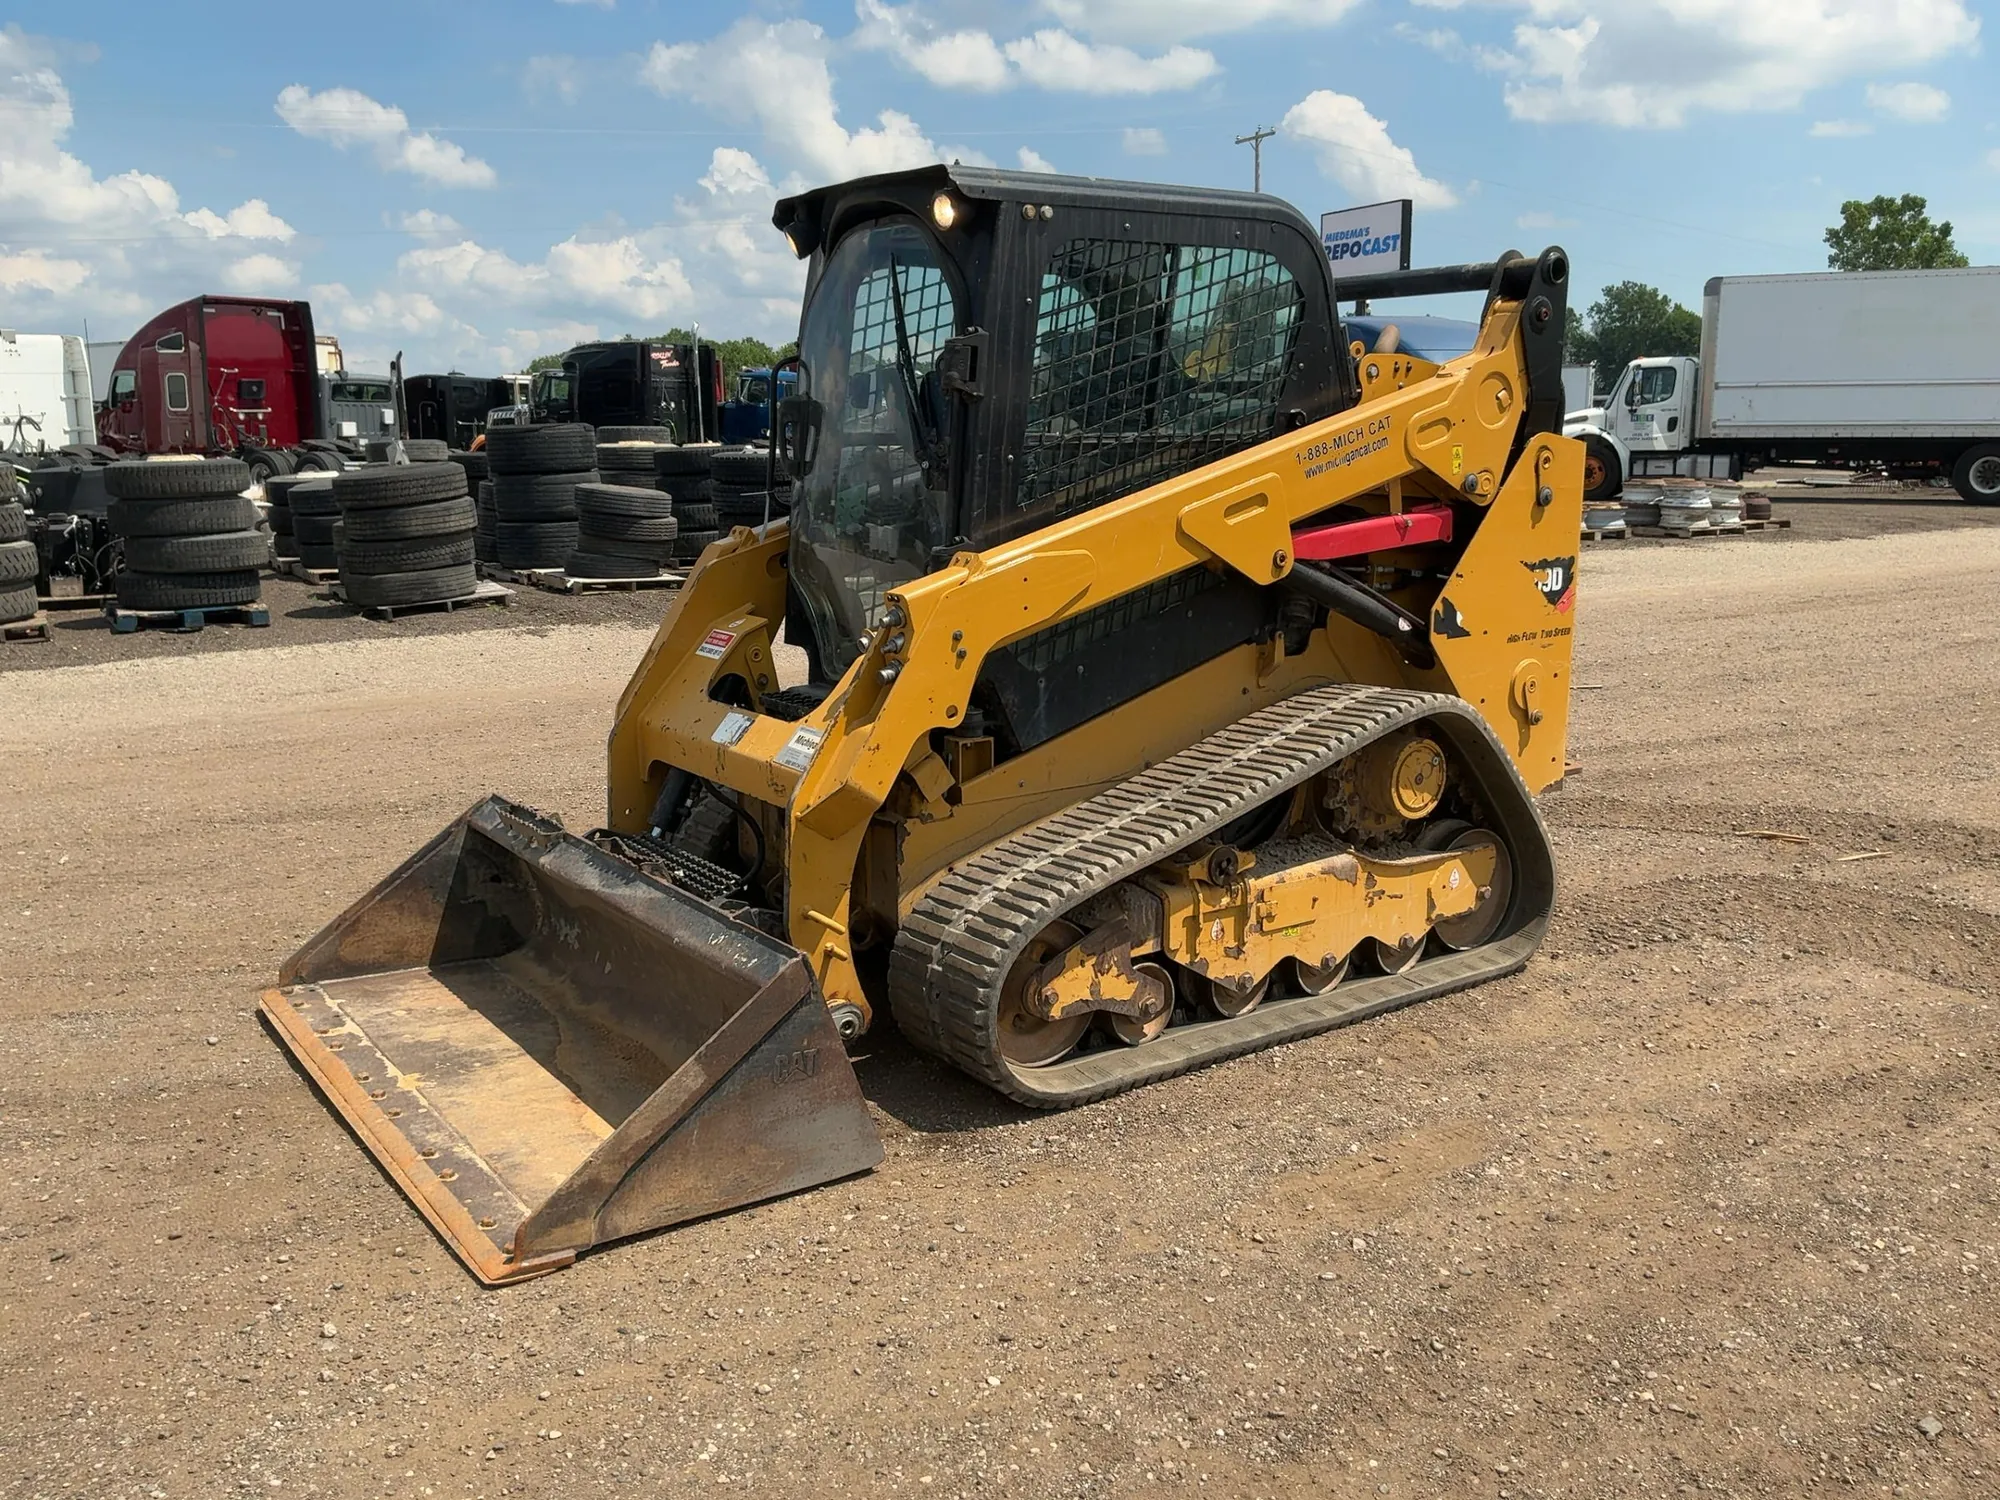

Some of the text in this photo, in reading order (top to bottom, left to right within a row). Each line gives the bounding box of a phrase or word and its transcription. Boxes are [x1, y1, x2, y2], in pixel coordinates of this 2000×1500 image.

[1325, 227, 1370, 243] MIEDEMA'S
[1295, 415, 1392, 465] 1-888-MICH CAT
[774, 1048, 819, 1084] CAT
